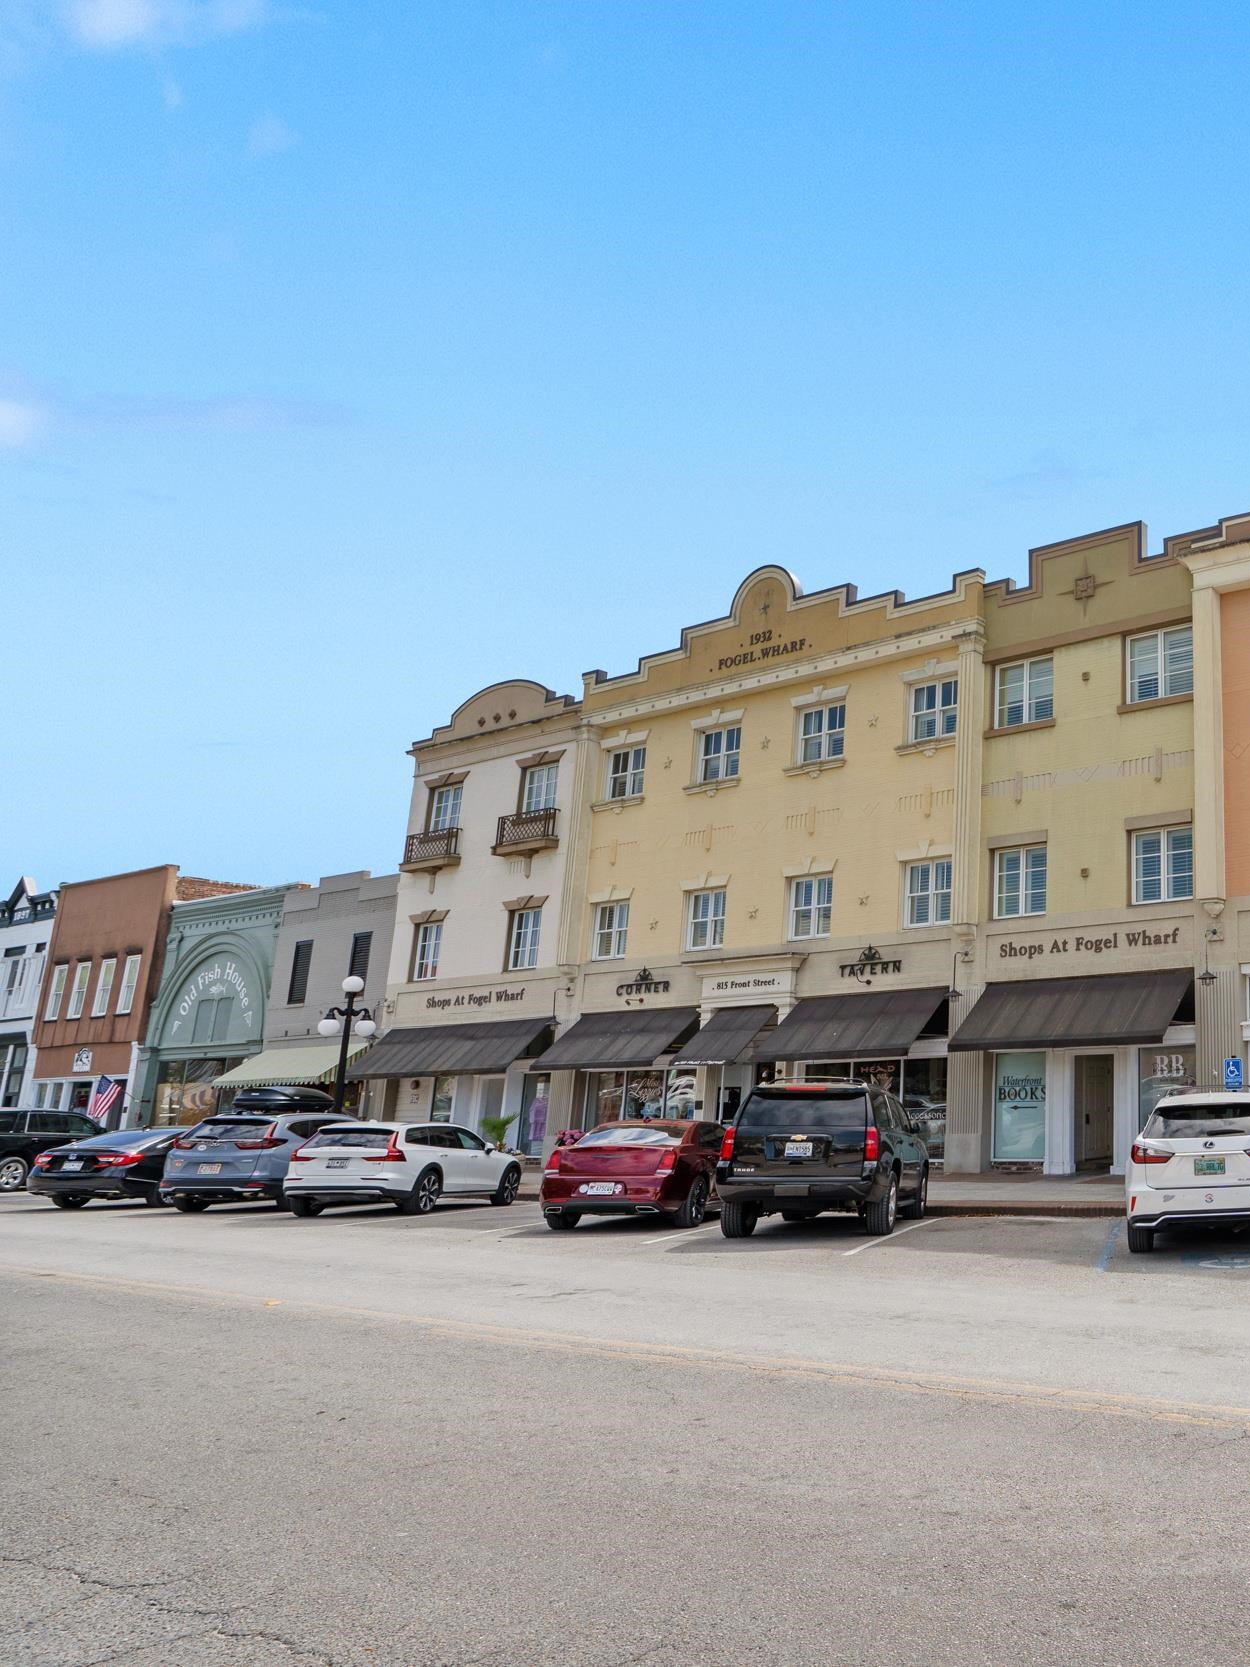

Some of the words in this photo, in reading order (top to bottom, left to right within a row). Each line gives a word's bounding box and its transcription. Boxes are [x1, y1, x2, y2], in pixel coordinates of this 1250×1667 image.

[749, 629, 773, 646] 1932
[1000, 941, 1044, 959] Shops
[1050, 939, 1068, 954] At
[1075, 932, 1118, 953] Fogel
[1125, 927, 1179, 947] Wharf
[839, 959, 902, 978] TAVERN
[179, 984, 198, 1015] Old
[198, 963, 221, 991] Fish
[223, 961, 249, 1009] House
[616, 980, 670, 997] CORNER
[716, 981, 729, 990] 815
[730, 980, 751, 989] Front
[752, 978, 775, 987] Street
[426, 995, 452, 1010] Shops
[453, 995, 465, 1006] At
[467, 991, 492, 1007] Fogel
[495, 988, 526, 1002] Wharf
[1002, 1075, 1043, 1088] Waterfront
[998, 1086, 1046, 1101] BOOKS
